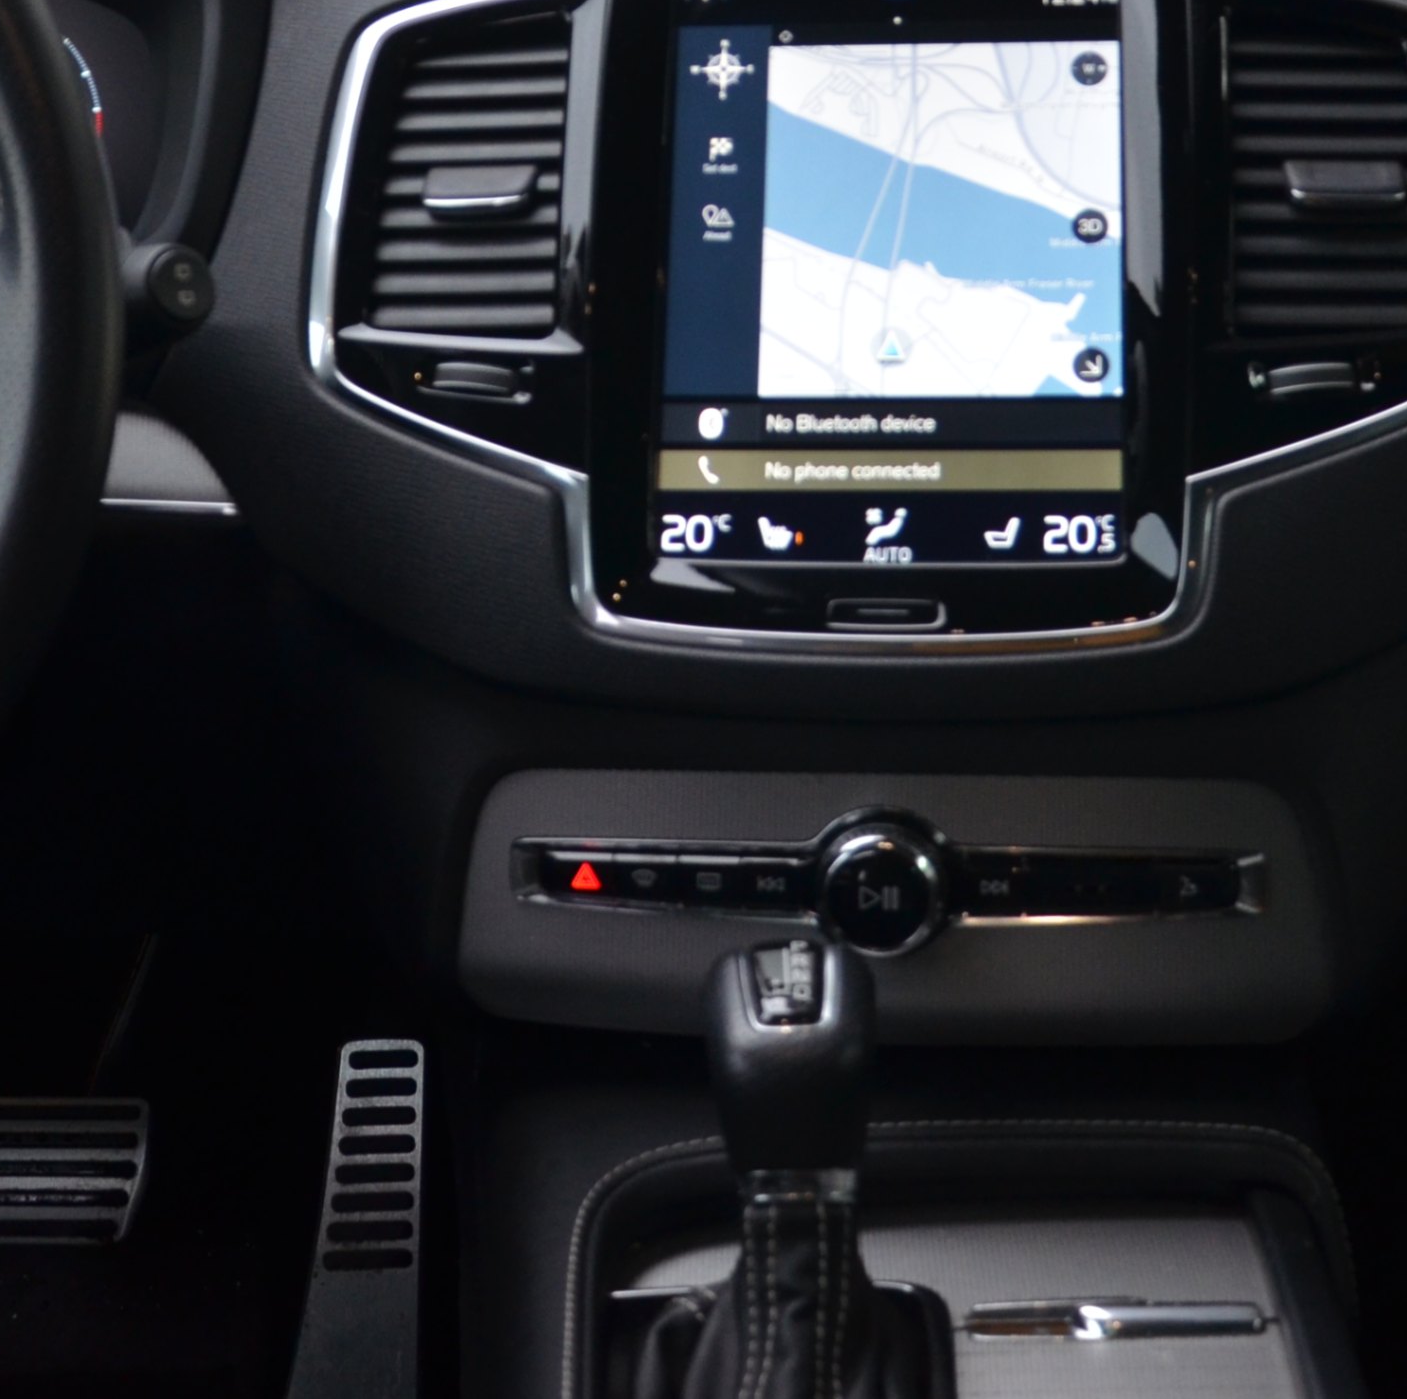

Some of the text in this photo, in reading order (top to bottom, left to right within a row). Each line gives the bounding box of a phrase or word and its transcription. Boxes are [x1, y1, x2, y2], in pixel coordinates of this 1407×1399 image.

[1077, 218, 1103, 235] 3D
[765, 413, 936, 433] No Bluetooth device
[765, 461, 941, 483] No phone connected
[863, 546, 913, 563] AUTO
